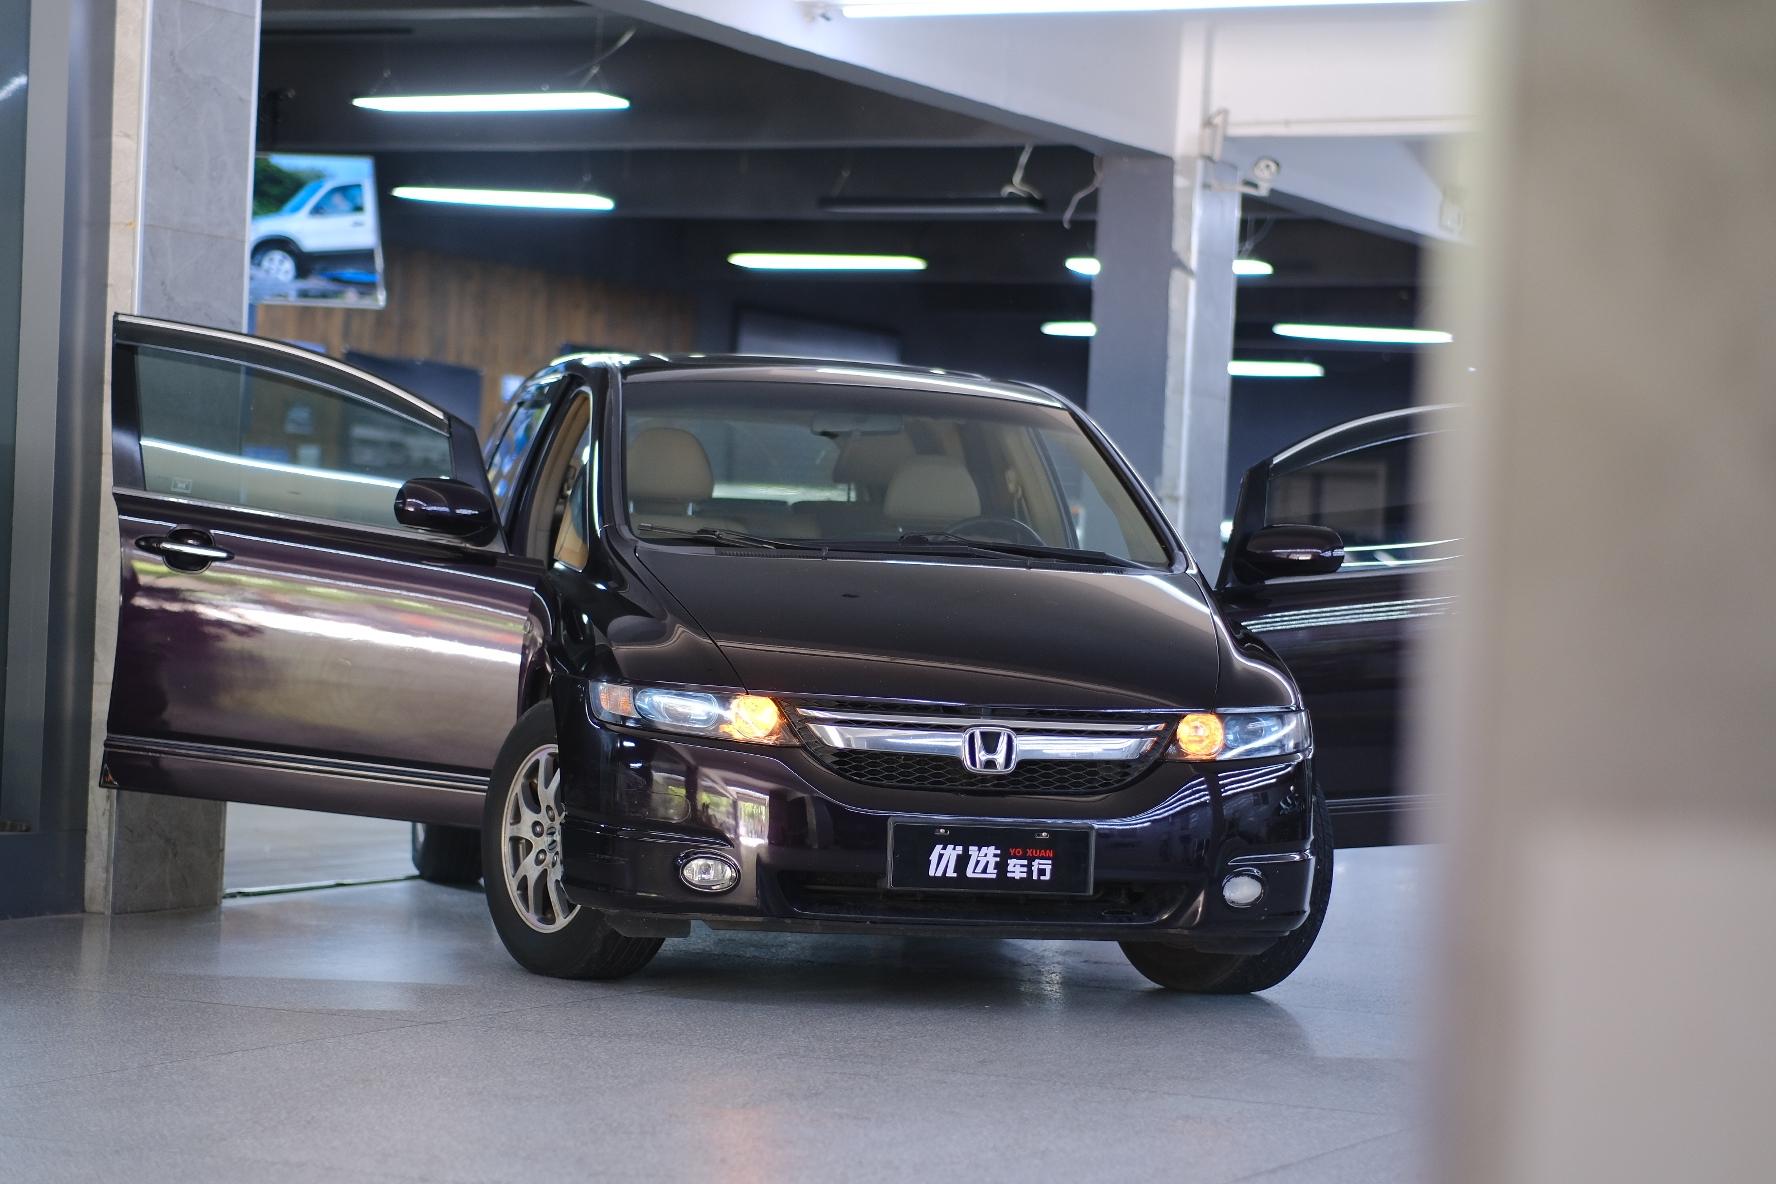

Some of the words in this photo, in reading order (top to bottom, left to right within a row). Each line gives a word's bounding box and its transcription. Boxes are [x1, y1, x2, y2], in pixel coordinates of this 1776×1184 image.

[928, 844, 1001, 879] 优选
[1008, 847, 1023, 856] YO
[1026, 848, 1053, 857] XUAN
[1006, 858, 1052, 880] 车行
